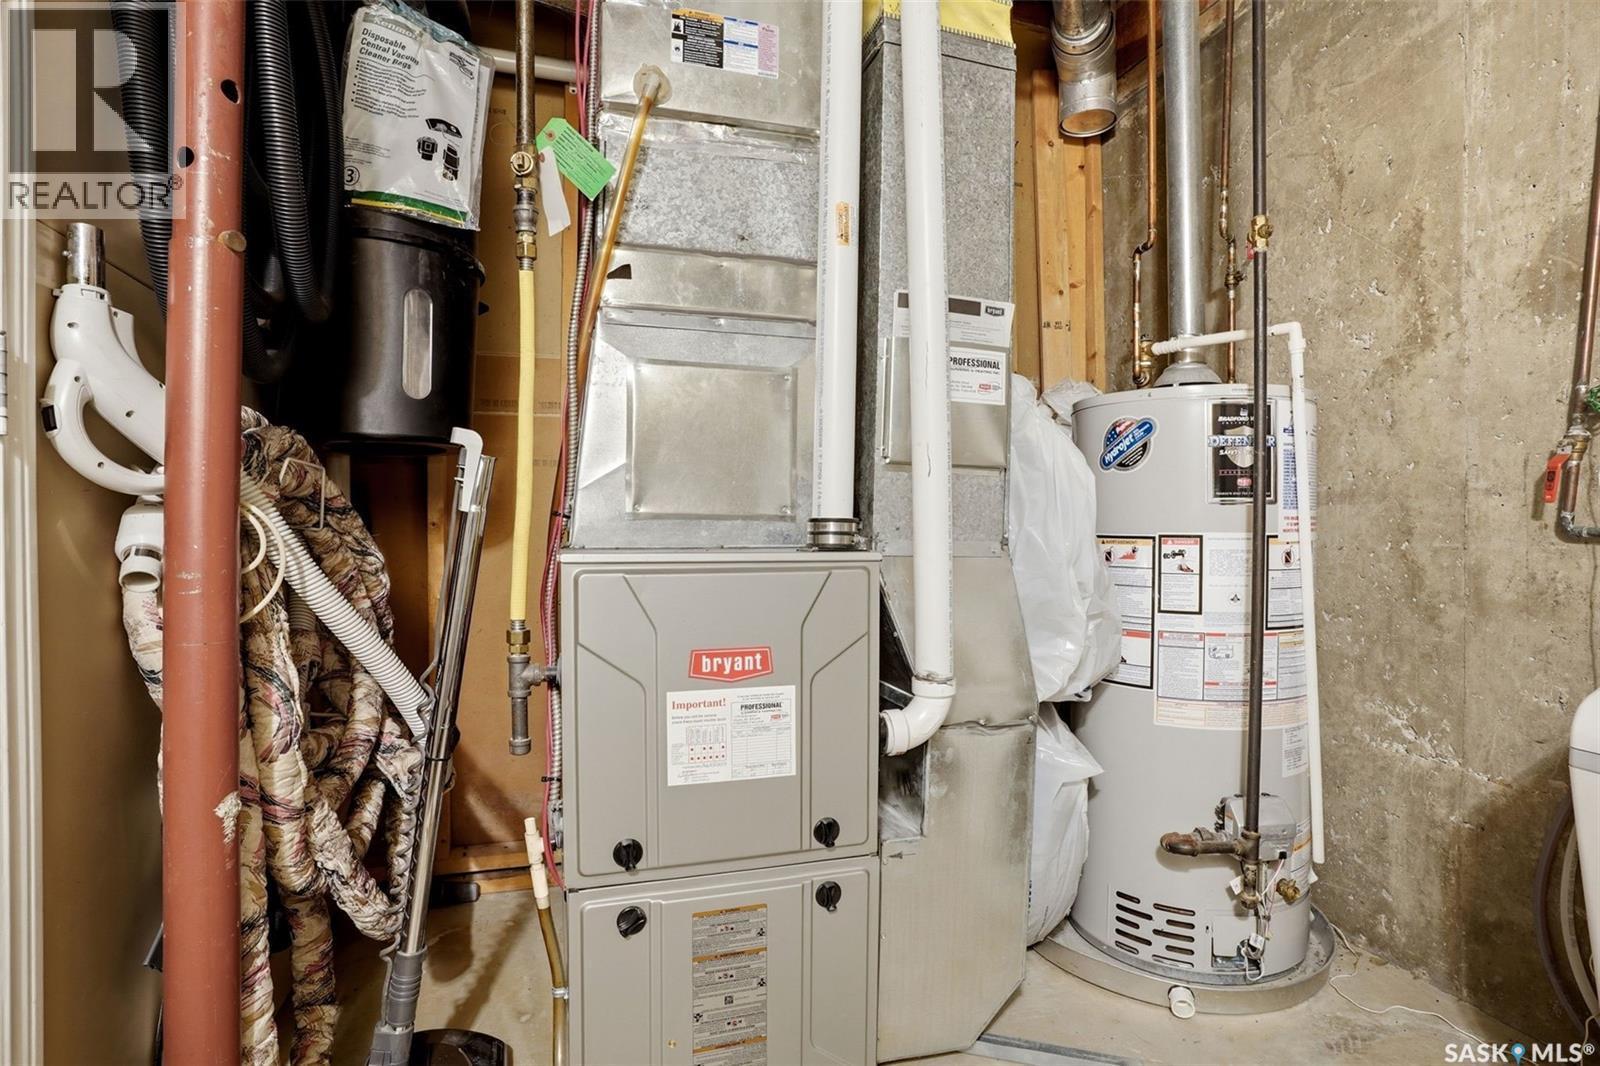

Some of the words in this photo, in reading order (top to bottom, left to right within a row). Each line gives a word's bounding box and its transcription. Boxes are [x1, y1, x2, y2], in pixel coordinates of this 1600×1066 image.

[361, 27, 407, 51] Disposable
[359, 46, 391, 64] Cleaner
[391, 58, 412, 70] Bags
[360, 37, 391, 54] Central
[391, 48, 420, 66] Vacuum
[345, 168, 355, 183] 3
[1208, 434, 1277, 447] DEFENR
[701, 652, 762, 674] bryant
[671, 697, 727, 711] Important!
[740, 701, 783, 711] PROFESSIONAL
